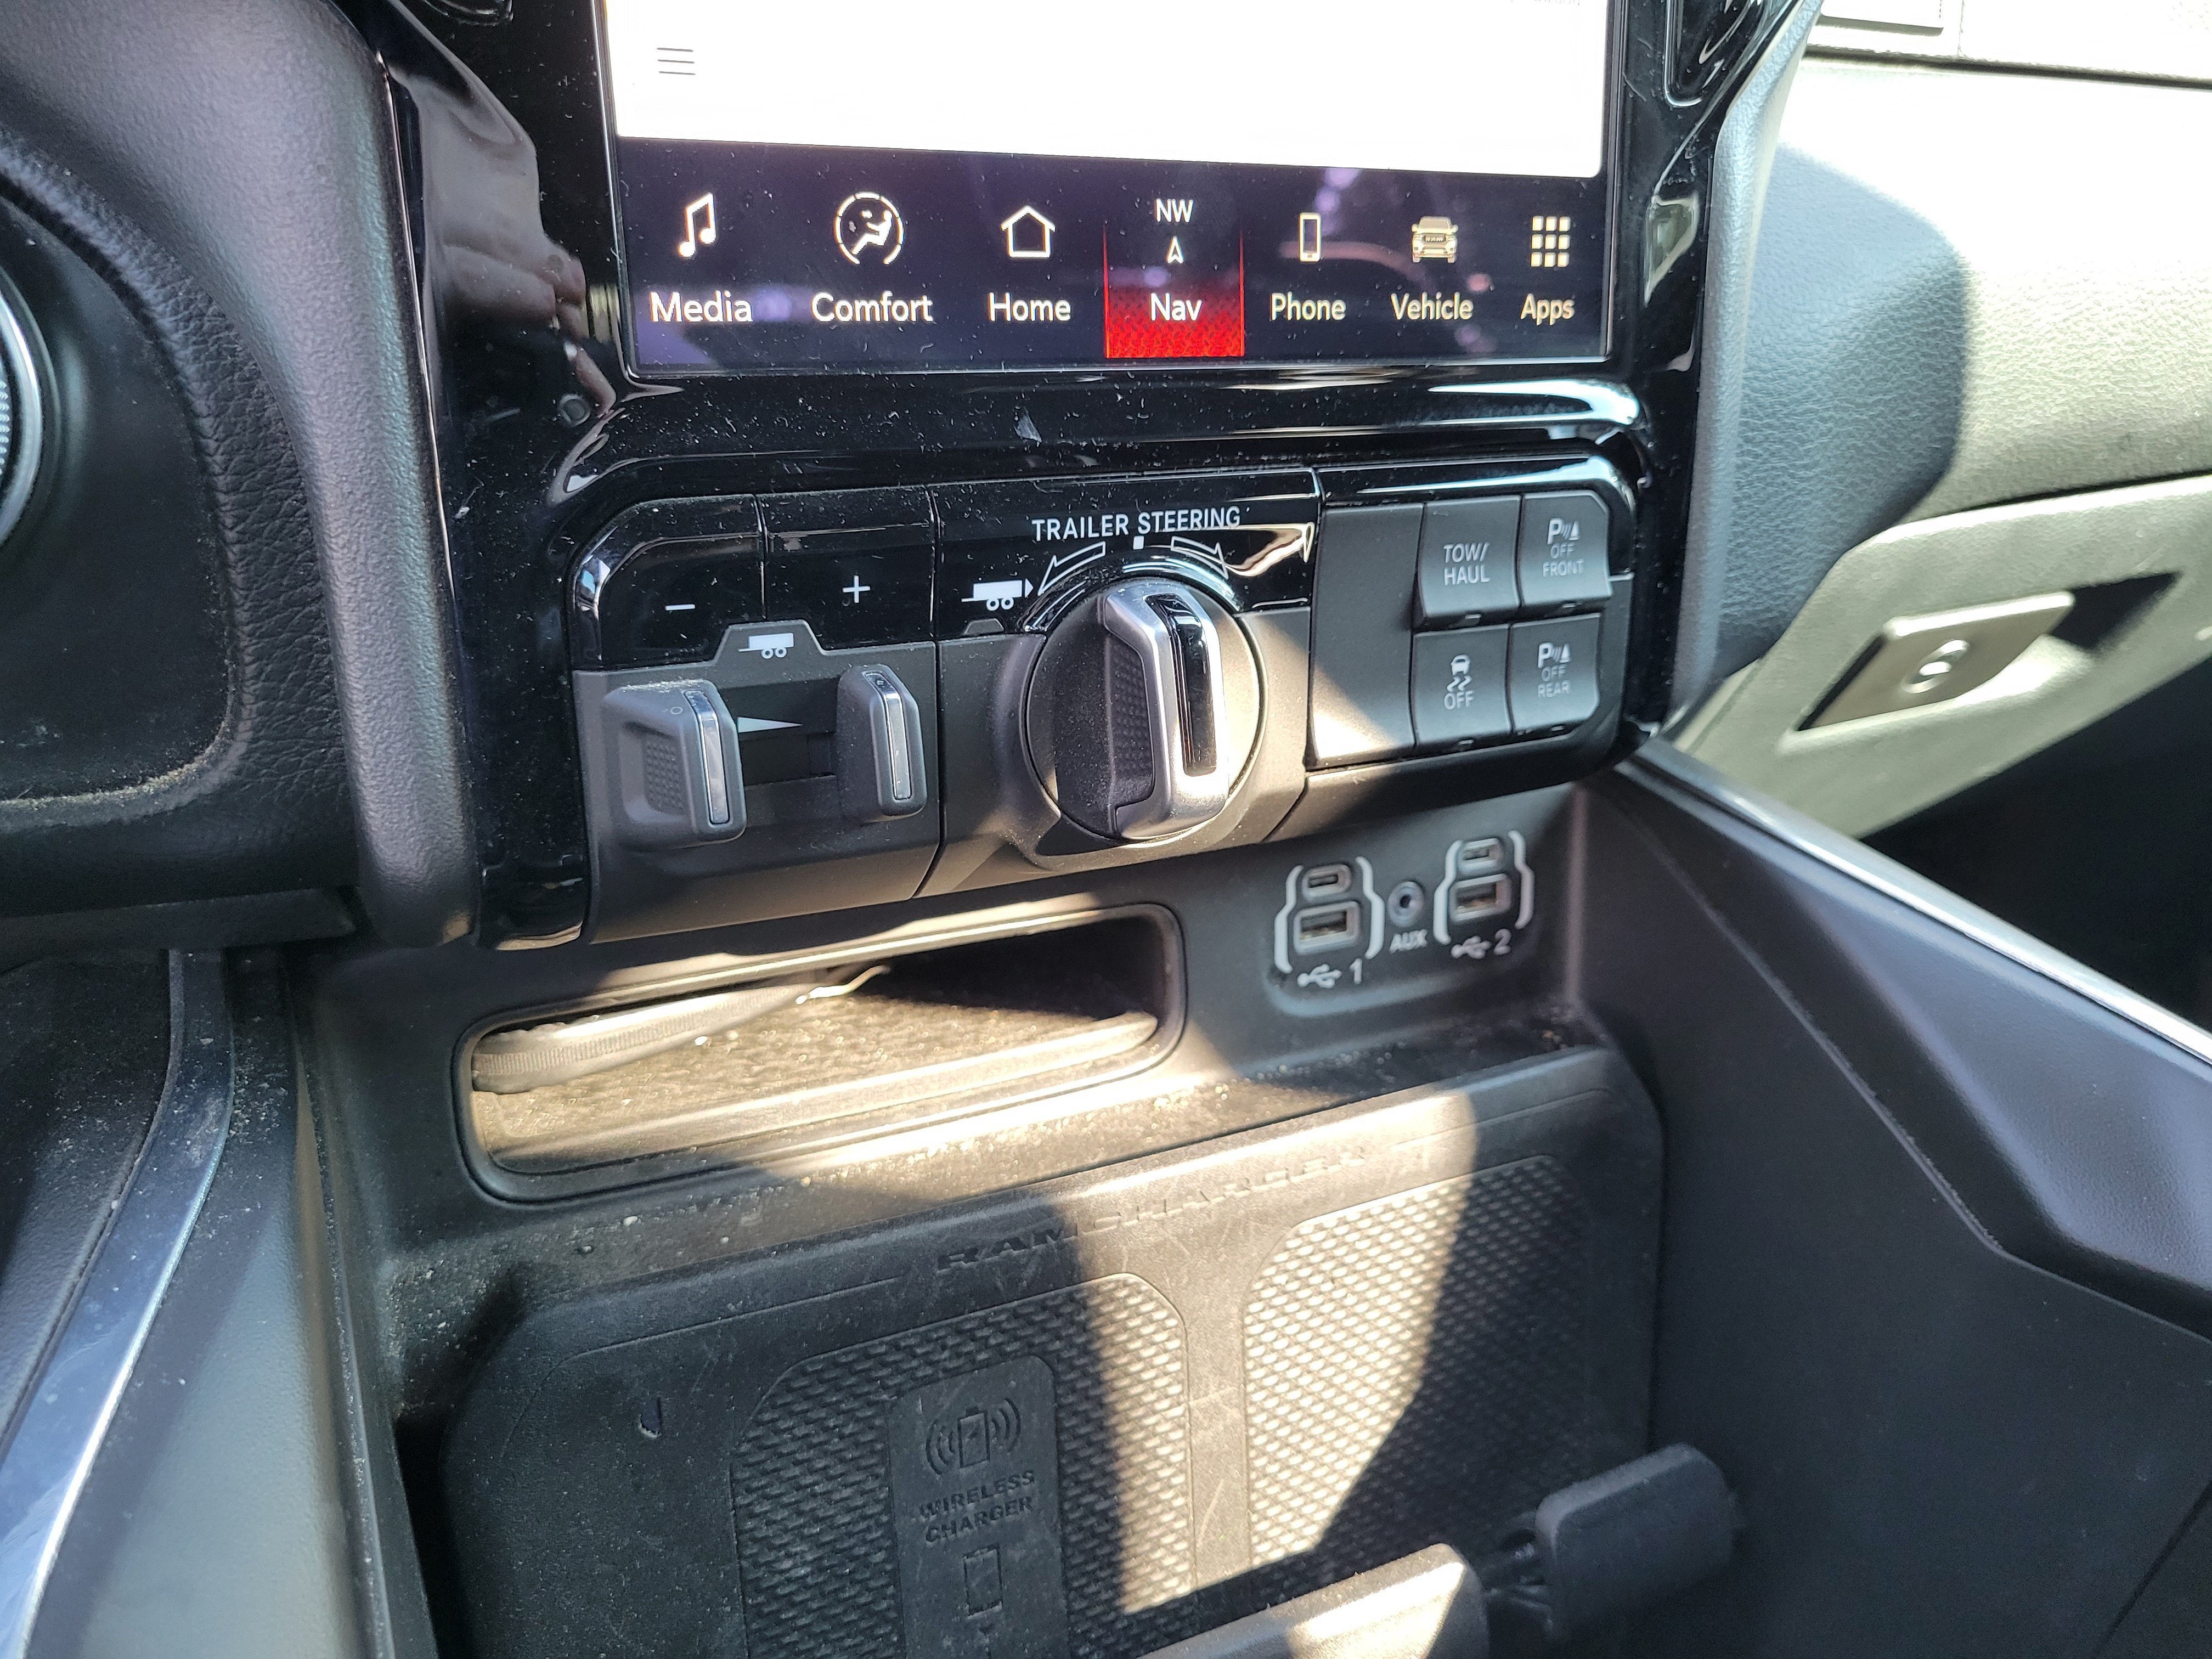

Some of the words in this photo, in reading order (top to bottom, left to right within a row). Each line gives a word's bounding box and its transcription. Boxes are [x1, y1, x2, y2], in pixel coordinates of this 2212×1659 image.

[1155, 199, 1193, 222] NW
[650, 291, 753, 323] Media
[811, 291, 934, 322] Comfort
[989, 294, 1071, 322] Home
[1150, 294, 1202, 321] Nav
[1271, 292, 1346, 320] Phone
[1391, 292, 1474, 320] Vehicle
[1521, 294, 1575, 325] Apps
[1032, 514, 1129, 541] TRAILER
[1137, 506, 1241, 536] STEERING
[1443, 542, 1489, 563] TOW/
[1550, 543, 1576, 559] OFF
[1444, 564, 1491, 586] HAUL
[1543, 558, 1584, 578] FRONT
[1541, 665, 1566, 682] OFF
[1443, 690, 1475, 710] OFF
[1538, 680, 1571, 698] REAR
[1389, 929, 1427, 953] AUX
[1493, 928, 1512, 956] 2
[1349, 957, 1363, 985] 1
[919, 1469, 1036, 1519] WIRELESS
[925, 1494, 1034, 1543] CHARGER
